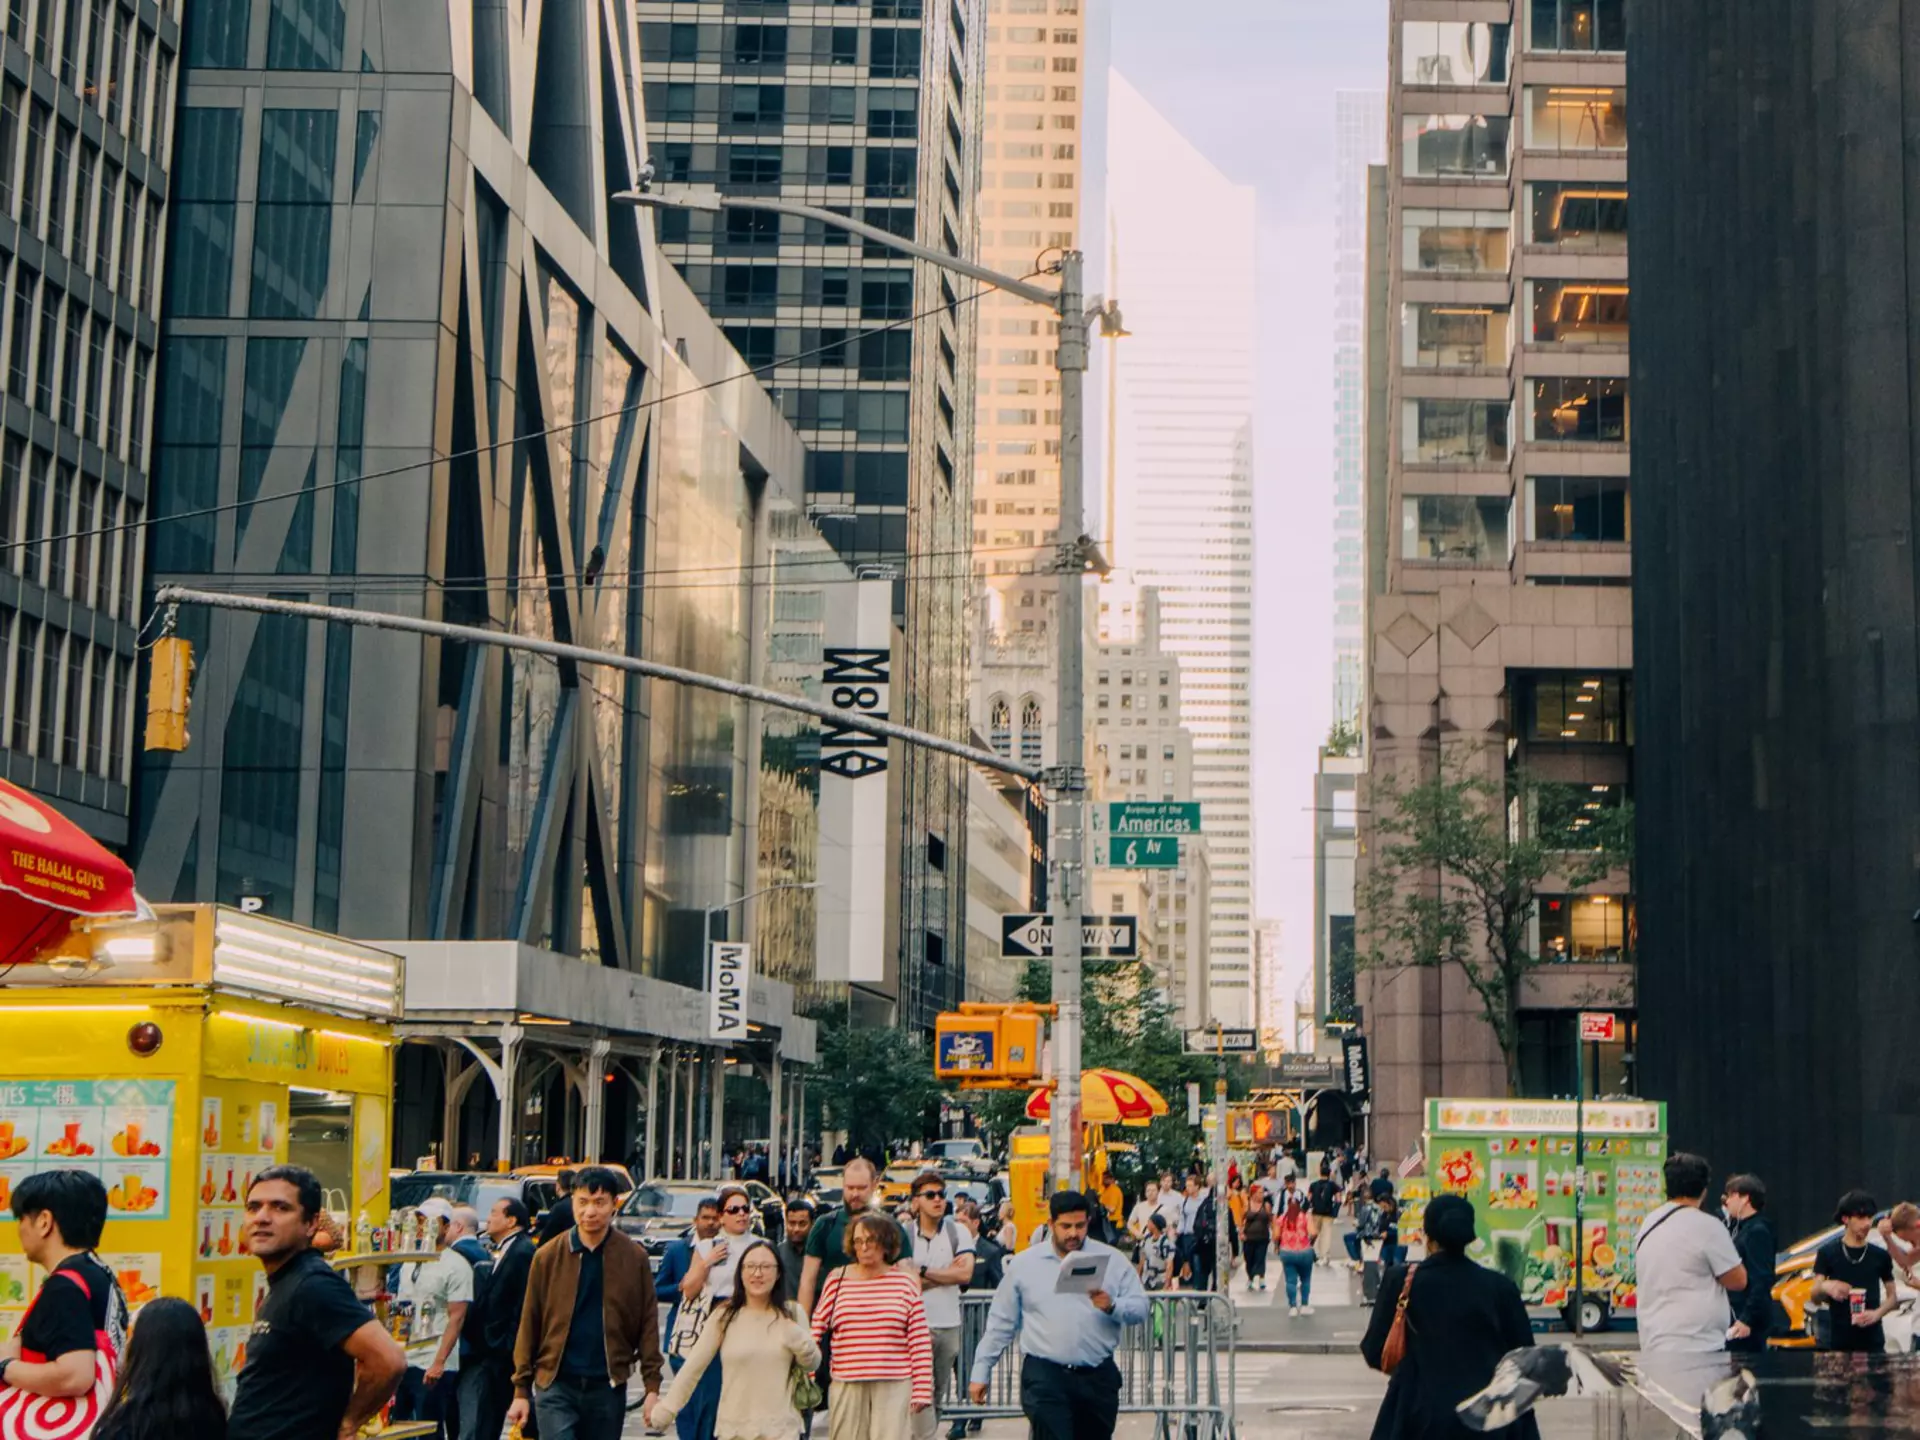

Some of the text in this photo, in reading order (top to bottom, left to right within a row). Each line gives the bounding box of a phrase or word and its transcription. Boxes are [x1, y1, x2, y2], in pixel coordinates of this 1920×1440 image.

[1117, 815, 1191, 833] Americas
[1126, 839, 1162, 865] 6 Av
[11, 850, 36, 870] THE
[37, 857, 75, 882] HALAL
[75, 869, 106, 891] GUYS
[1028, 928, 1122, 944] ON WAY
[718, 946, 743, 1032] MoMA
[1226, 1036, 1248, 1045] WAY
[1347, 1045, 1365, 1094] MoMA
